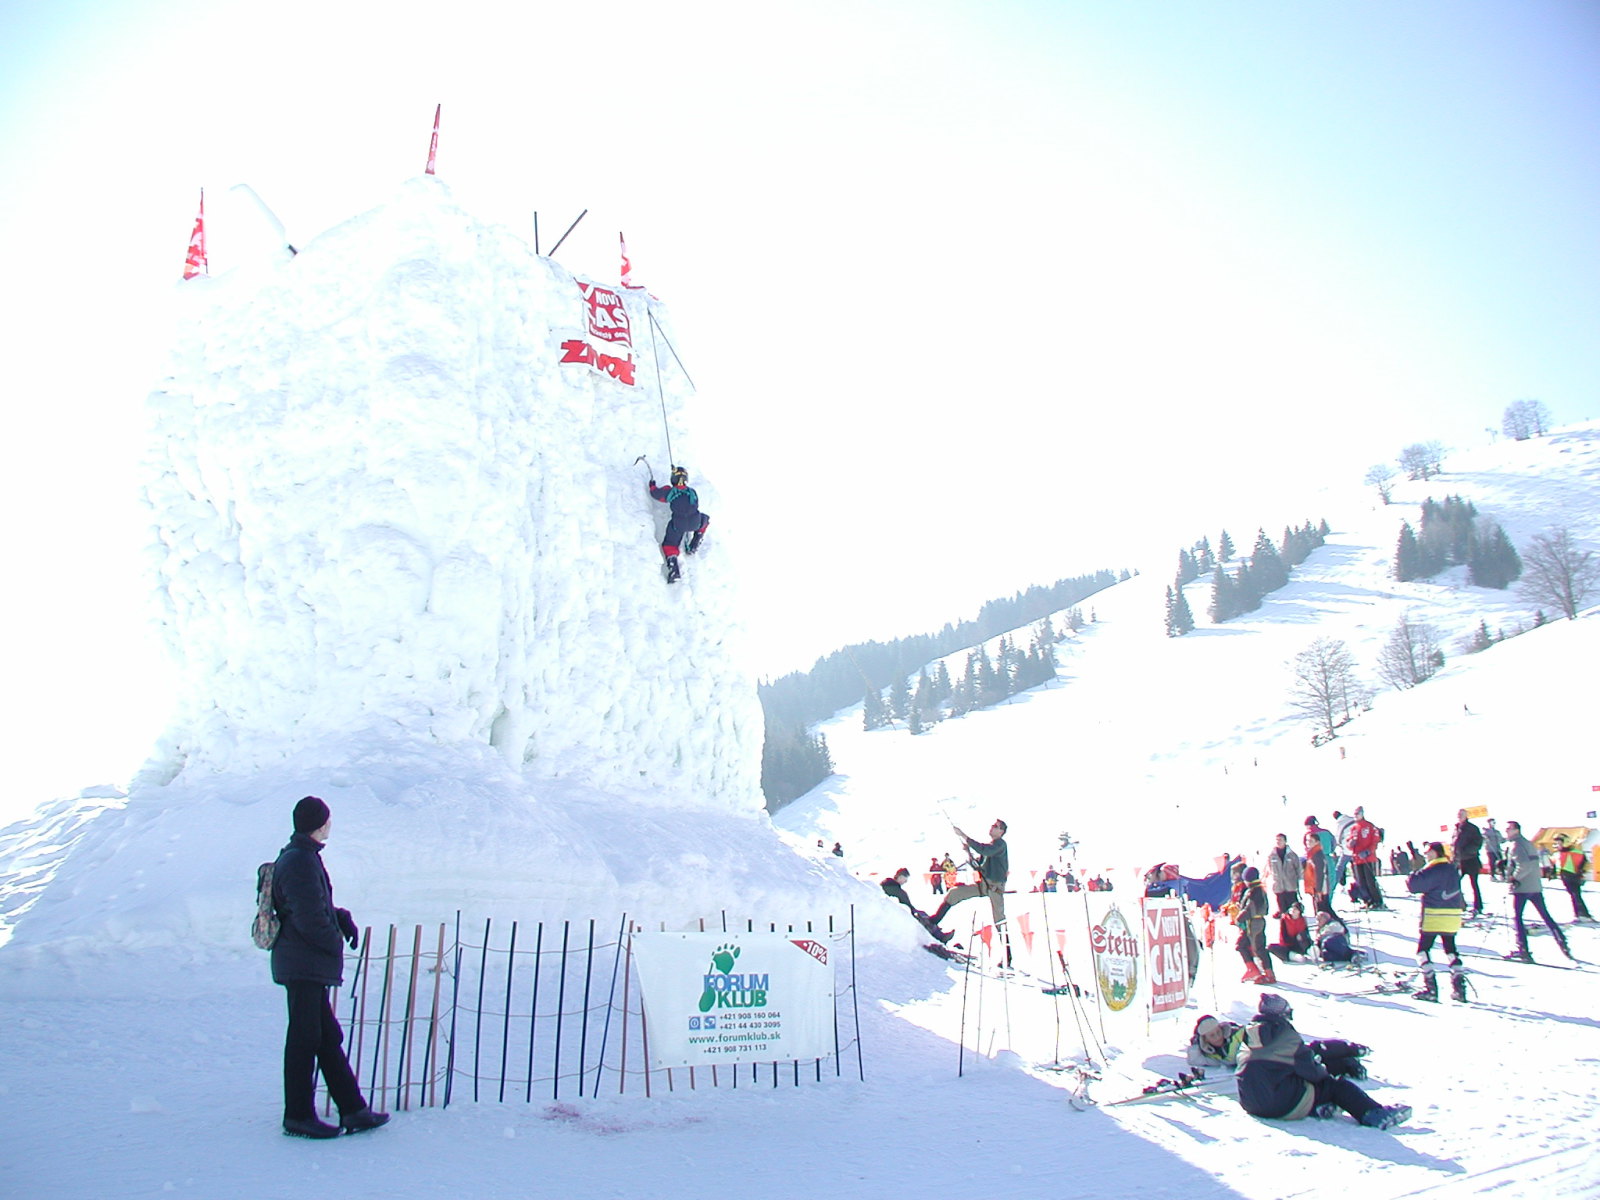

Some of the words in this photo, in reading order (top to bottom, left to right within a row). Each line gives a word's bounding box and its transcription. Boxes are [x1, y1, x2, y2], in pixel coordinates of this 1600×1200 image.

[1092, 924, 1140, 958] Stein
[703, 973, 769, 992] FORUM
[717, 989, 768, 1009] KLUB
[688, 1031, 781, 1044] www.forumklub.sk
